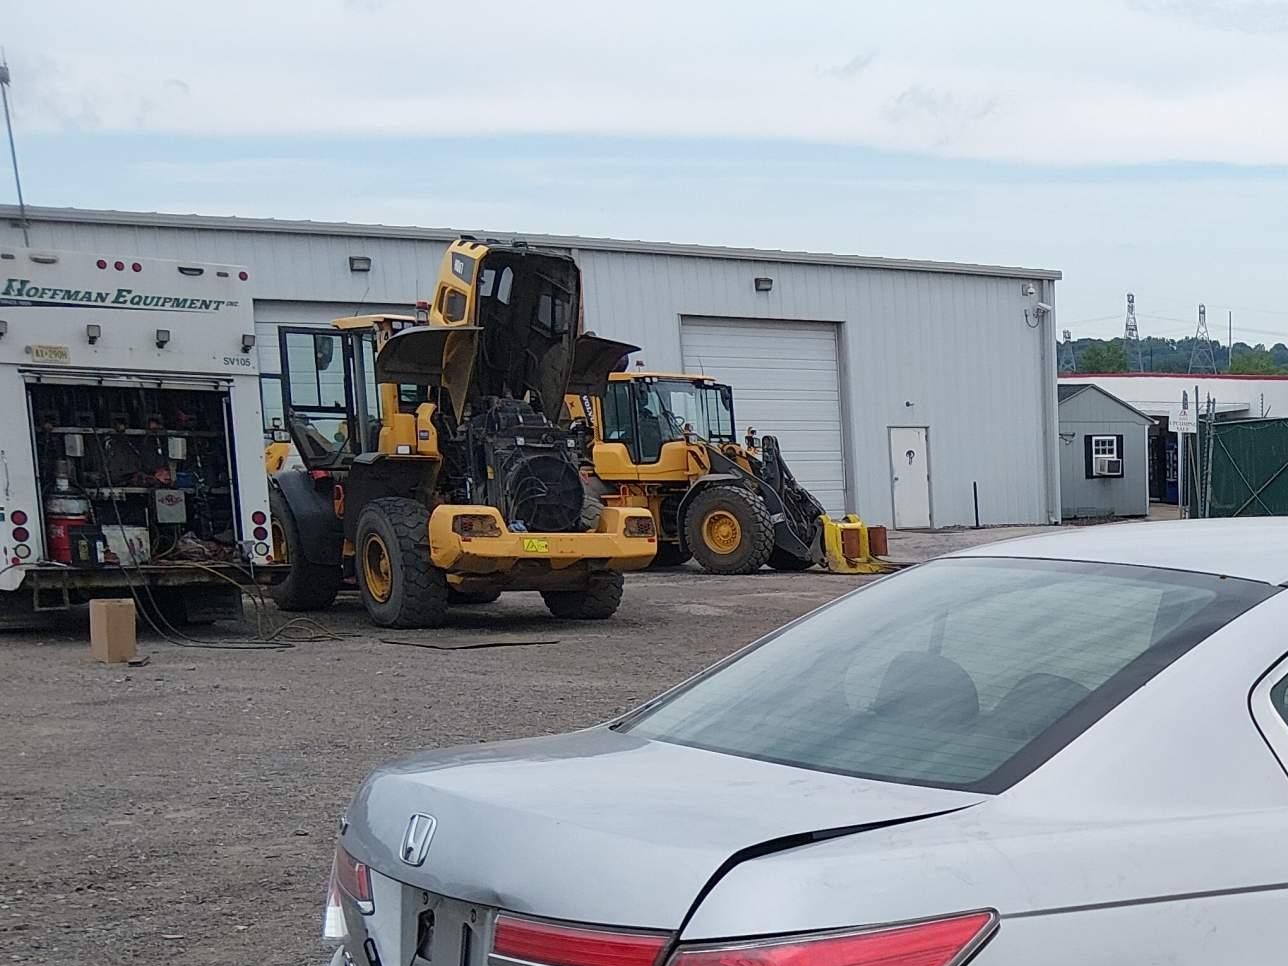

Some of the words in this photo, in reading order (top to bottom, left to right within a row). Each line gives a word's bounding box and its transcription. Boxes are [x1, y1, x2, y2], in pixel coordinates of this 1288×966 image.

[1, 278, 110, 303] HOFFMAN
[111, 288, 225, 311] EQUIPMENT
[223, 357, 251, 367] SV105
